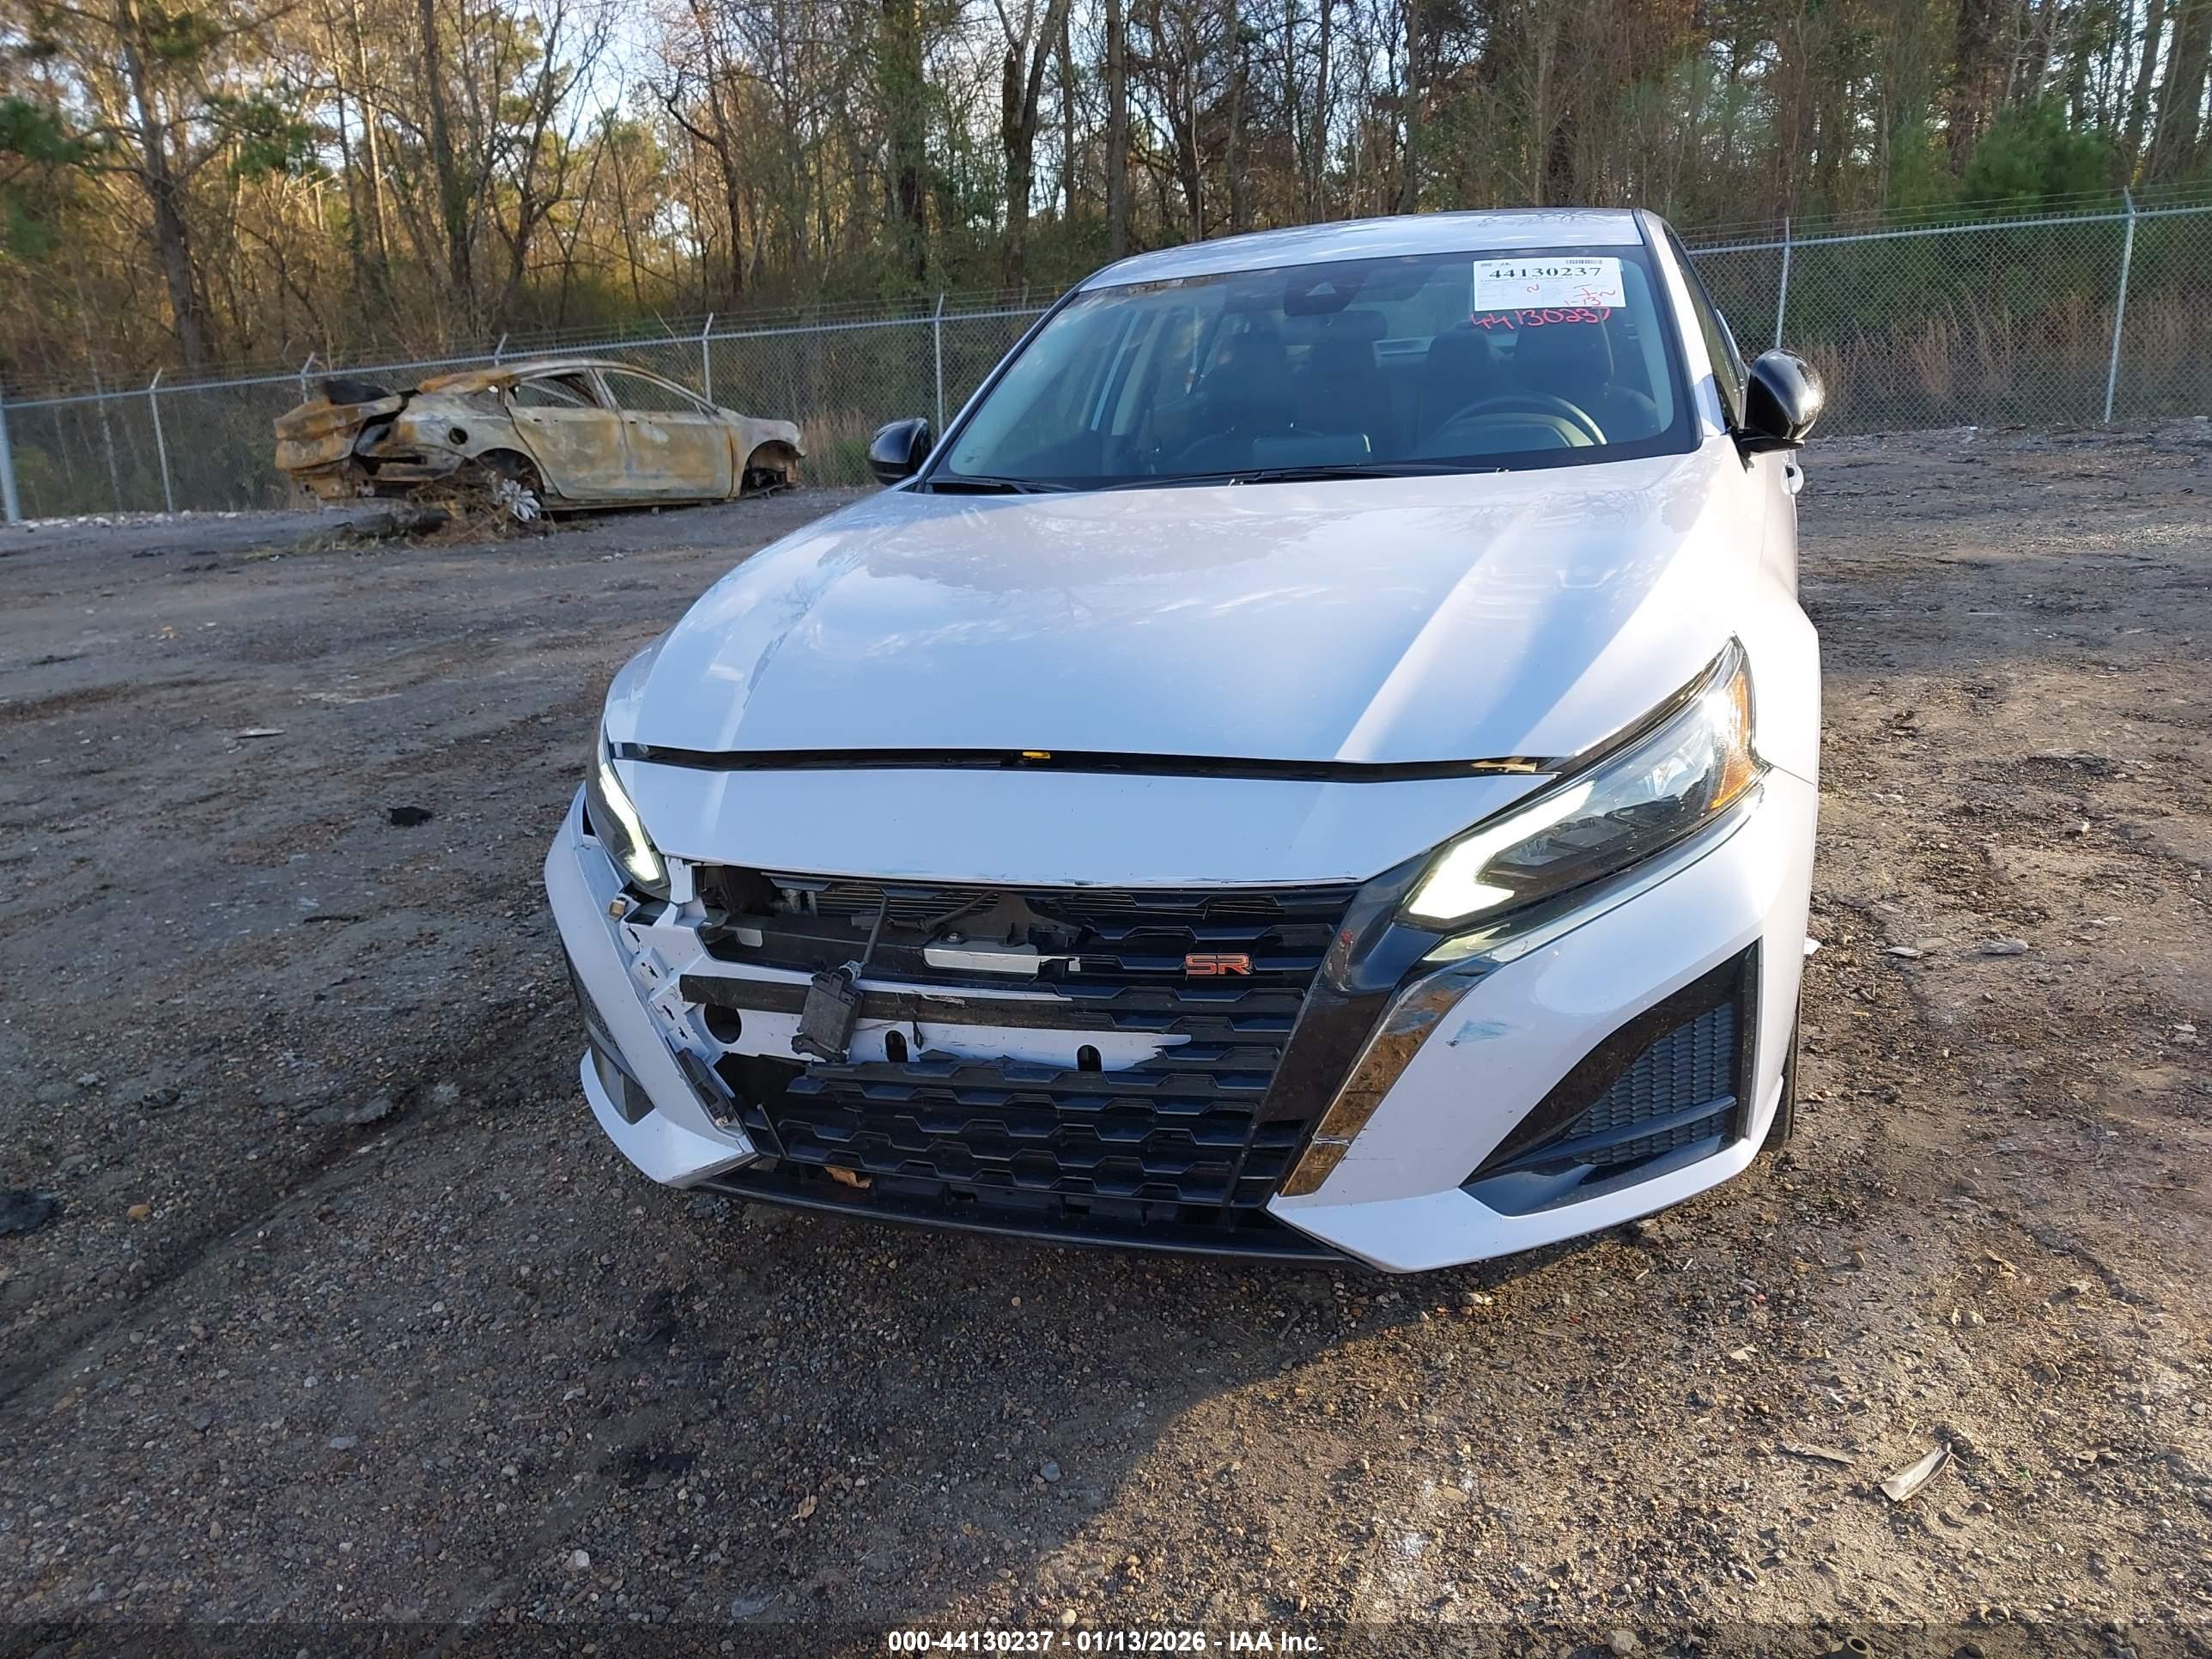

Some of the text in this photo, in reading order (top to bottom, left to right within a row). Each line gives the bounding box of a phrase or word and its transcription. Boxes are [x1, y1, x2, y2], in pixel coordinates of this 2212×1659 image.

[1489, 267, 1601, 278] 44130237
[1470, 307, 1611, 330] 44130237
[1185, 952, 1251, 975] SR
